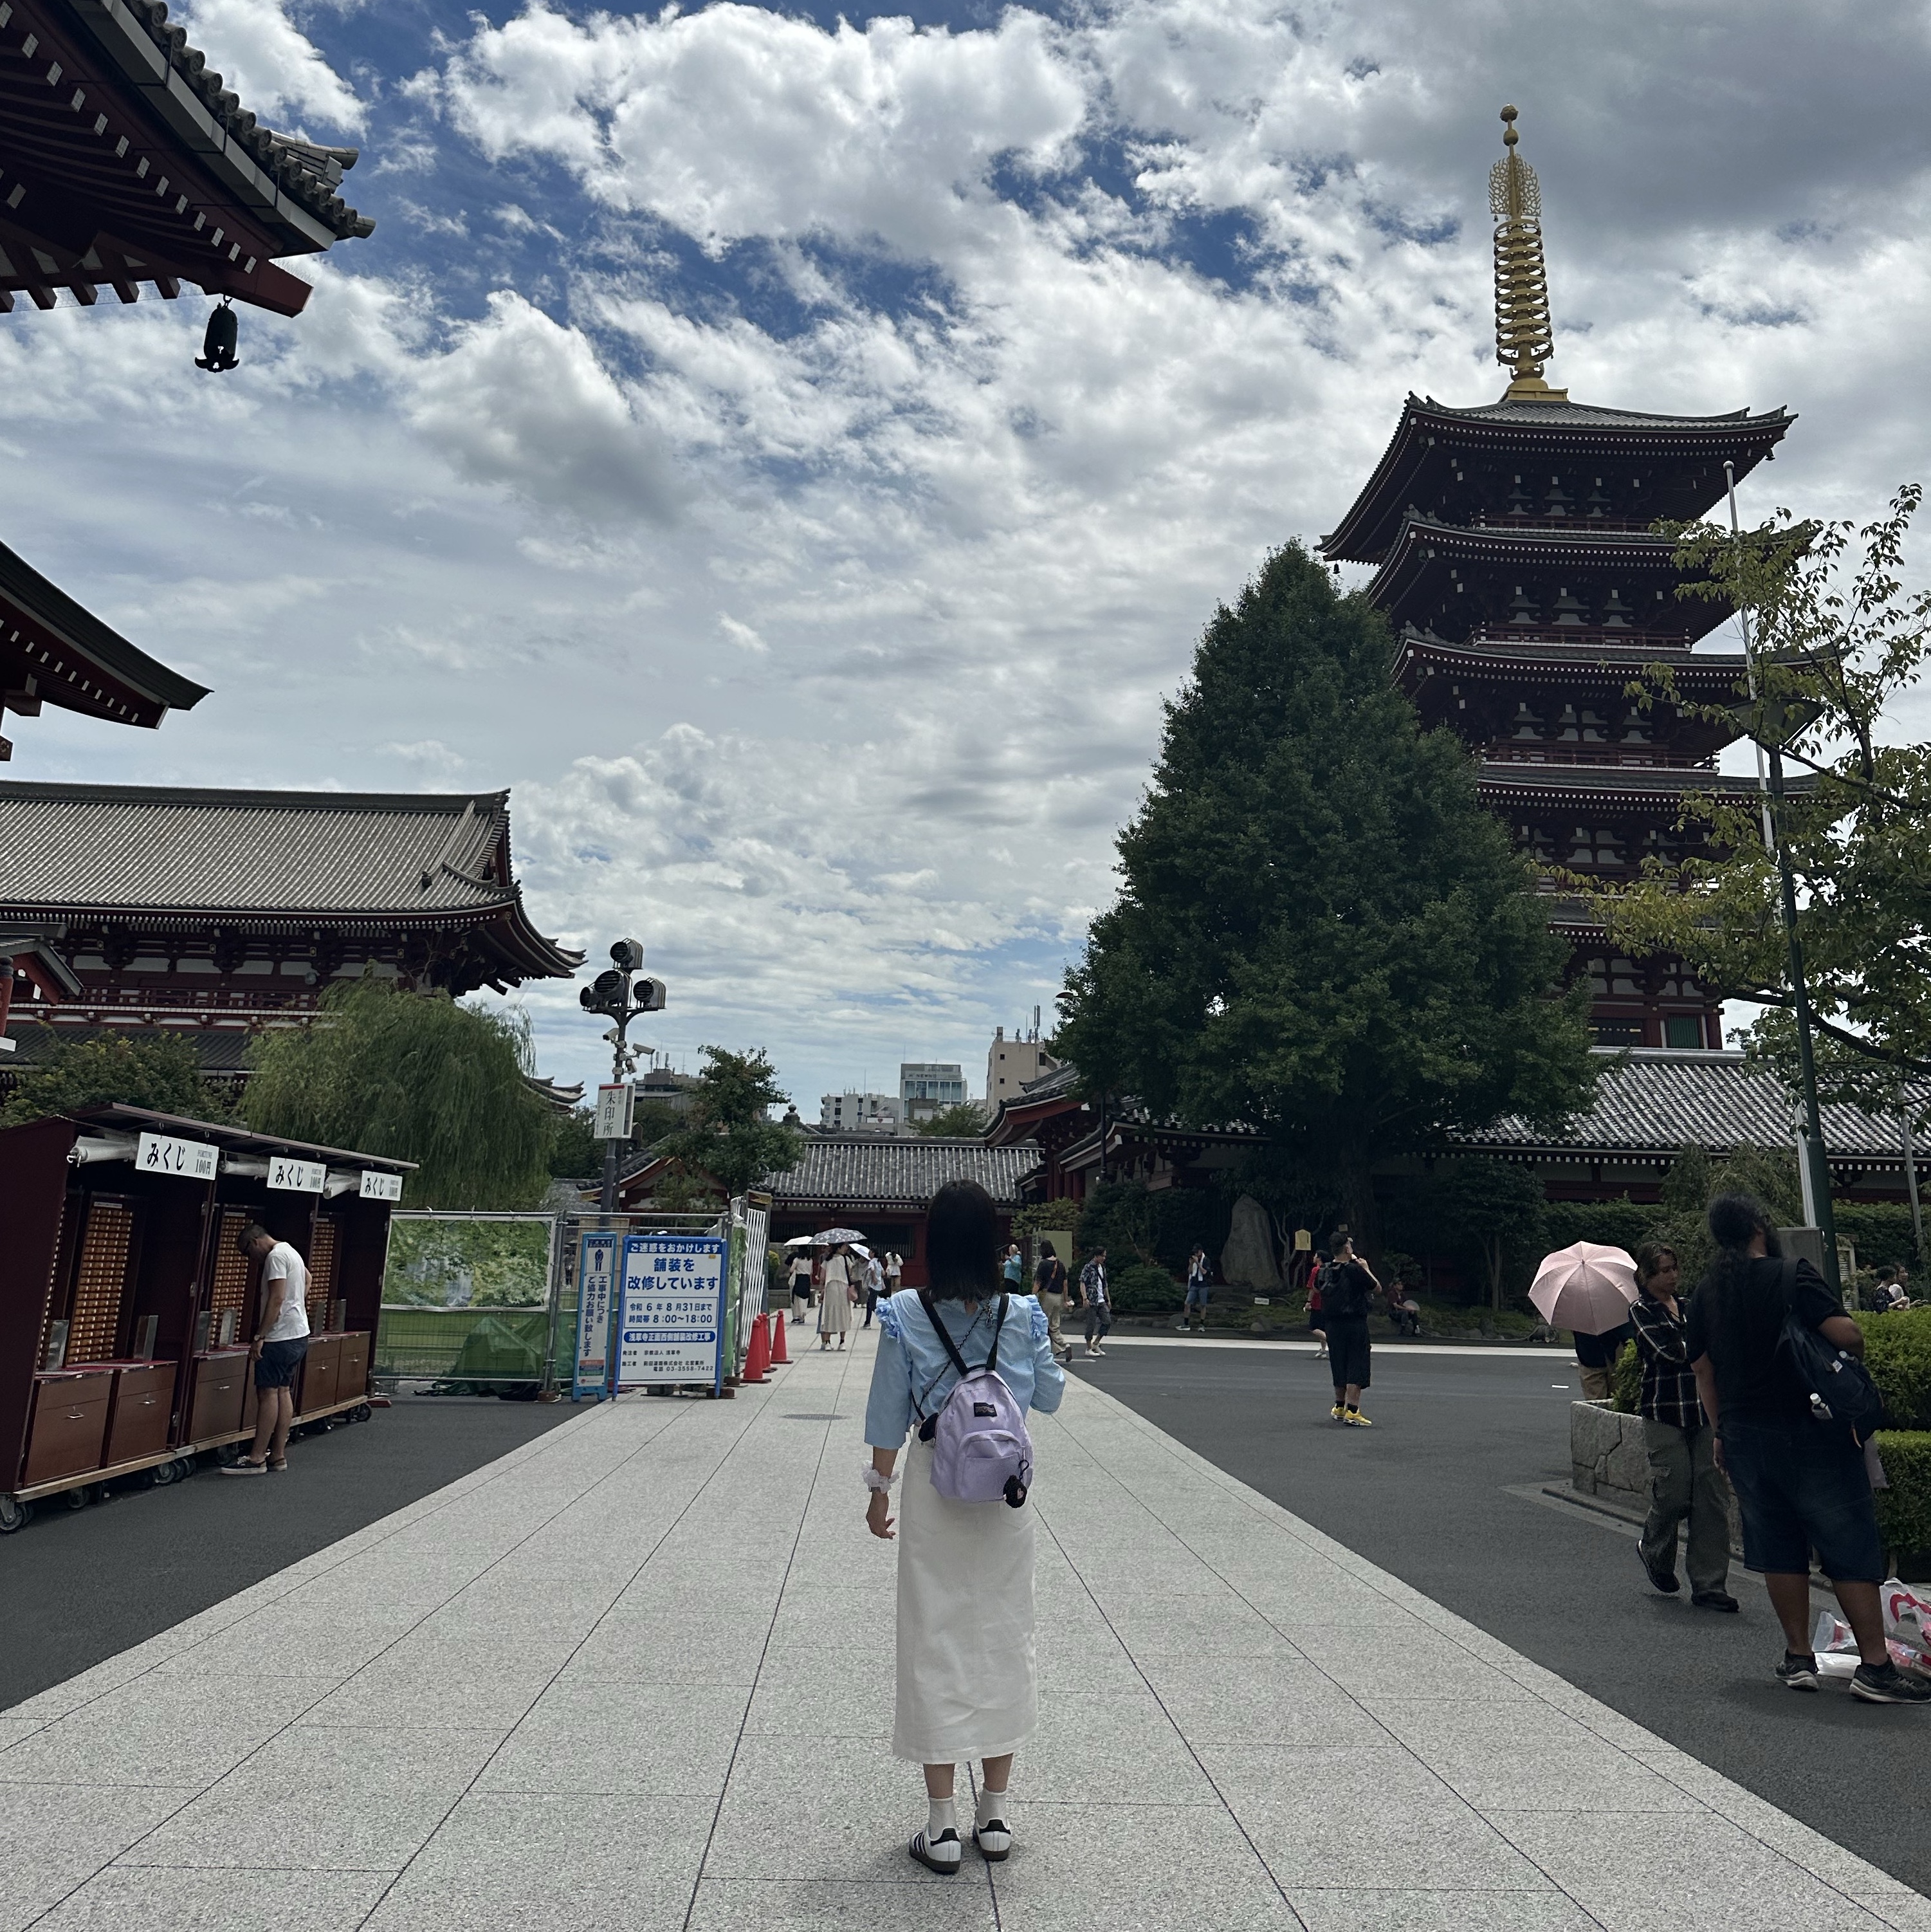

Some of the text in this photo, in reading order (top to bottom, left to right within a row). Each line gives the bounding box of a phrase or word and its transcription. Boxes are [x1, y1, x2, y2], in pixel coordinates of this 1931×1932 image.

[603, 1090, 616, 1136] 朱印所
[147, 1143, 185, 1171] みくじ
[275, 1164, 304, 1188] みくじ
[365, 1176, 384, 1196] みくじ
[630, 1242, 720, 1253] ご迷惑をおかけします
[654, 1257, 695, 1272] 舗装を
[628, 1276, 718, 1291] 改修しています
[597, 1276, 607, 1323] 工事中につき
[584, 1275, 596, 1357] ご協力お願い致します
